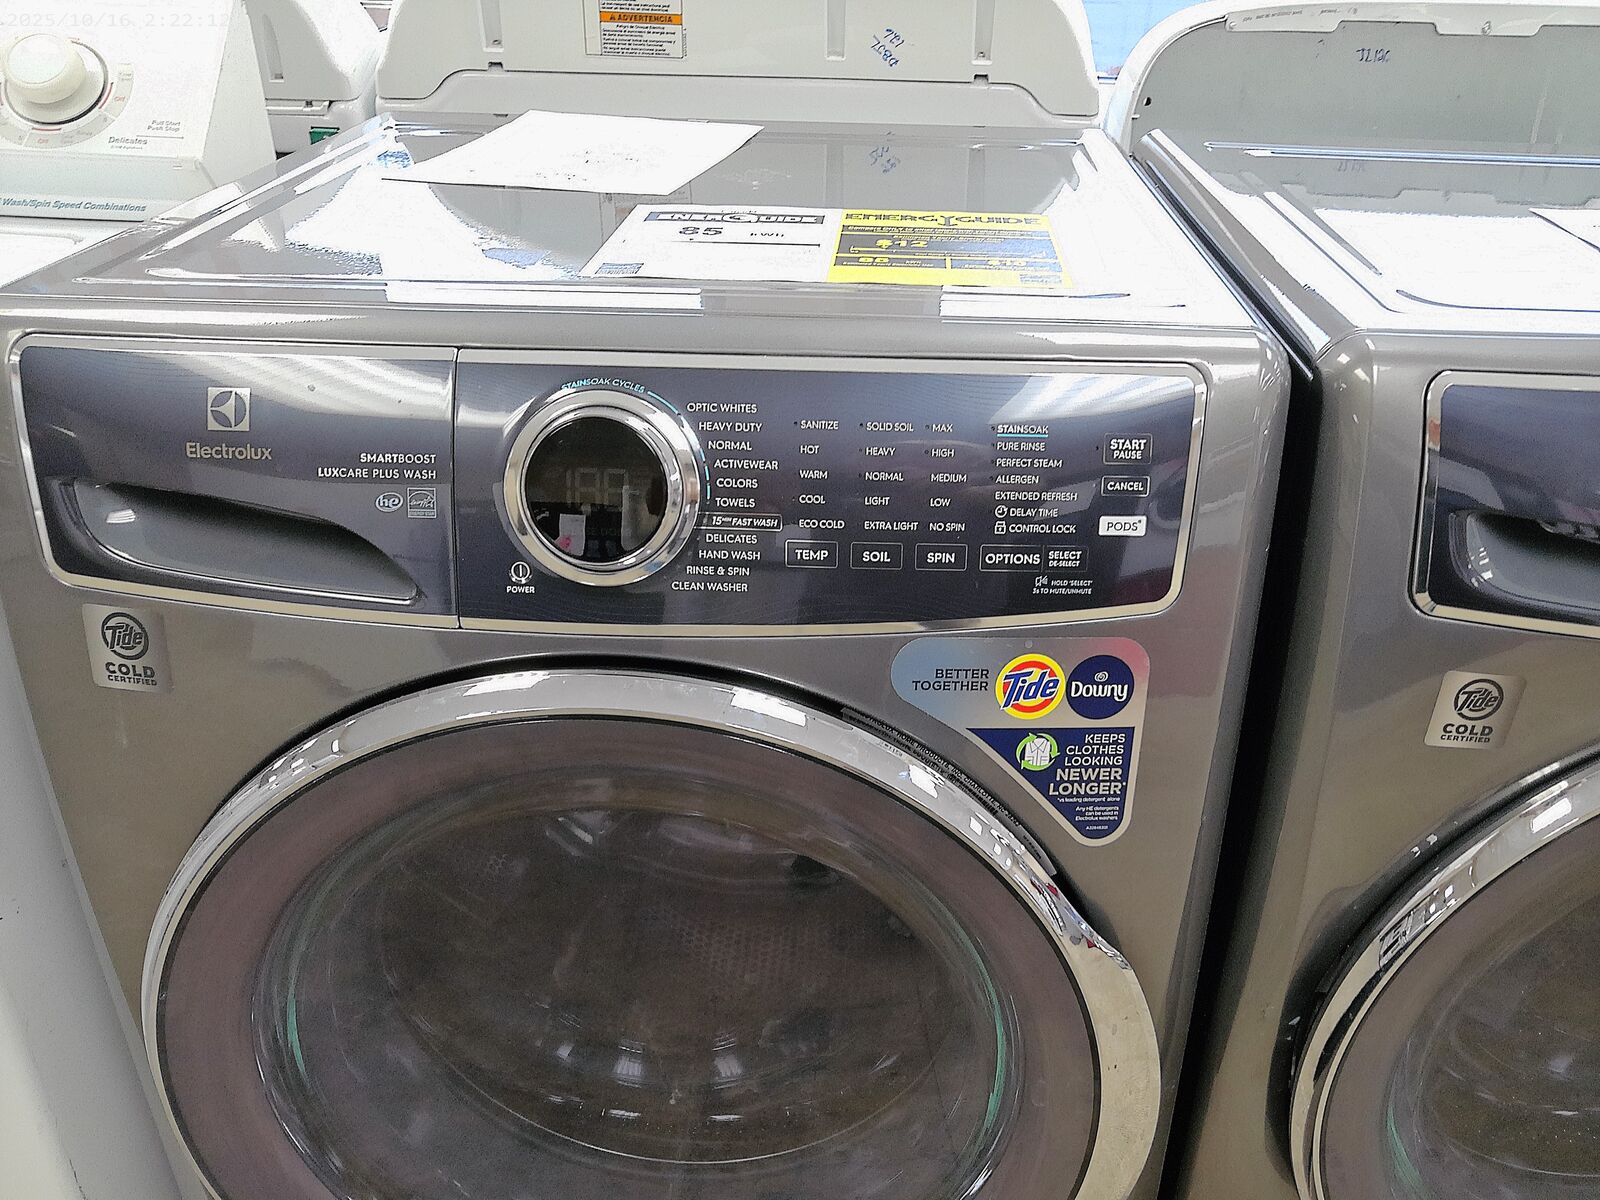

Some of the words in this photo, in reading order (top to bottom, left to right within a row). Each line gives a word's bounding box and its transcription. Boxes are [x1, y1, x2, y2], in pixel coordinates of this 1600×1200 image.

[617, 14, 673, 23] ADVERTENCIA
[108, 136, 148, 145] Delicates
[2, 198, 51, 209] Wash/Spin
[52, 200, 83, 210] Speed
[83, 202, 147, 212] Combinations
[679, 226, 724, 236] 85
[561, 378, 611, 390] STAINSOAK
[612, 379, 645, 393] CYCLES
[687, 403, 718, 413] OPTIC
[720, 404, 758, 414] WHITES
[699, 422, 732, 432] HEAVY
[735, 423, 762, 432] DUTY
[800, 420, 839, 430] SANITIZE
[866, 422, 893, 431] SOLID
[894, 423, 914, 432] SOIL
[932, 424, 953, 432] MAX
[997, 424, 1048, 434] STAINSOAK
[708, 441, 752, 451] NORMAL
[800, 445, 819, 454] HOT
[997, 442, 1019, 451] PURE
[1021, 442, 1046, 451] RINSE
[1110, 439, 1147, 450] START
[186, 442, 272, 460] Electrolux
[866, 447, 896, 456] HEAVY
[932, 449, 954, 458] HIGH
[1113, 450, 1142, 459] PAUSE
[359, 453, 436, 464] SMARTBOOST
[996, 458, 1032, 468] PERFECT
[1034, 459, 1063, 468] STEAM
[714, 459, 779, 470] ACTIVEWEAR
[317, 467, 369, 479] LUXCARE
[372, 468, 400, 479] PLUS
[404, 469, 437, 480] WASH
[800, 470, 828, 479] WARM
[865, 472, 904, 482] NORMAL
[930, 473, 967, 483] MEDIUM
[716, 478, 758, 489] COLORS
[995, 475, 1039, 484] ALLERGEN
[1107, 482, 1144, 491] CANCEL
[799, 495, 826, 504] COOL
[995, 491, 1040, 501] EXTENDED
[1041, 492, 1078, 501] REFRESH
[715, 497, 756, 508] TOWELS
[864, 497, 890, 506] LIGHT
[930, 498, 951, 507] LOW
[1010, 508, 1037, 517] DELAY
[1038, 508, 1059, 517] TIME
[732, 518, 752, 526] FAST
[753, 519, 778, 527] WASH
[799, 519, 818, 528] ECO
[819, 520, 845, 529] COLD
[864, 521, 892, 530] EXTRA
[893, 522, 919, 531] LIGHT
[929, 523, 944, 531] NO
[945, 523, 966, 532] SPIN
[1009, 525, 1050, 534] CONTROL
[1052, 525, 1077, 534] LOCK
[706, 534, 758, 544] DELICATES
[699, 550, 729, 560] HAND
[731, 551, 760, 561] WASH
[795, 549, 829, 561] TEMP
[862, 551, 891, 562] SOIL
[927, 552, 955, 564] SPIN
[985, 554, 1041, 565] OPTIONS
[1048, 551, 1082, 560] SELECT
[1048, 560, 1080, 568] DE-SELECT
[686, 566, 715, 575] RINSE
[717, 567, 726, 576] &
[728, 567, 750, 576] SPIN
[506, 586, 535, 594] POWER
[672, 581, 705, 590] CLEAN
[707, 582, 748, 592] WASHER
[105, 622, 143, 650] Tide
[105, 662, 156, 678] COLD
[935, 668, 990, 679] BETTER
[108, 675, 158, 686] CERTIFIED
[912, 680, 989, 692] TOGETHER
[1000, 668, 1060, 710] Tide
[1070, 681, 1129, 702] Downy
[1457, 688, 1499, 712] Tide
[1442, 723, 1494, 737] COLD
[1085, 734, 1126, 744] KEEPS
[1440, 735, 1491, 744] CERTIFIED
[1066, 745, 1124, 755] CLOTHES
[1064, 756, 1123, 766] LOOKING
[1056, 768, 1122, 781] NEWER
